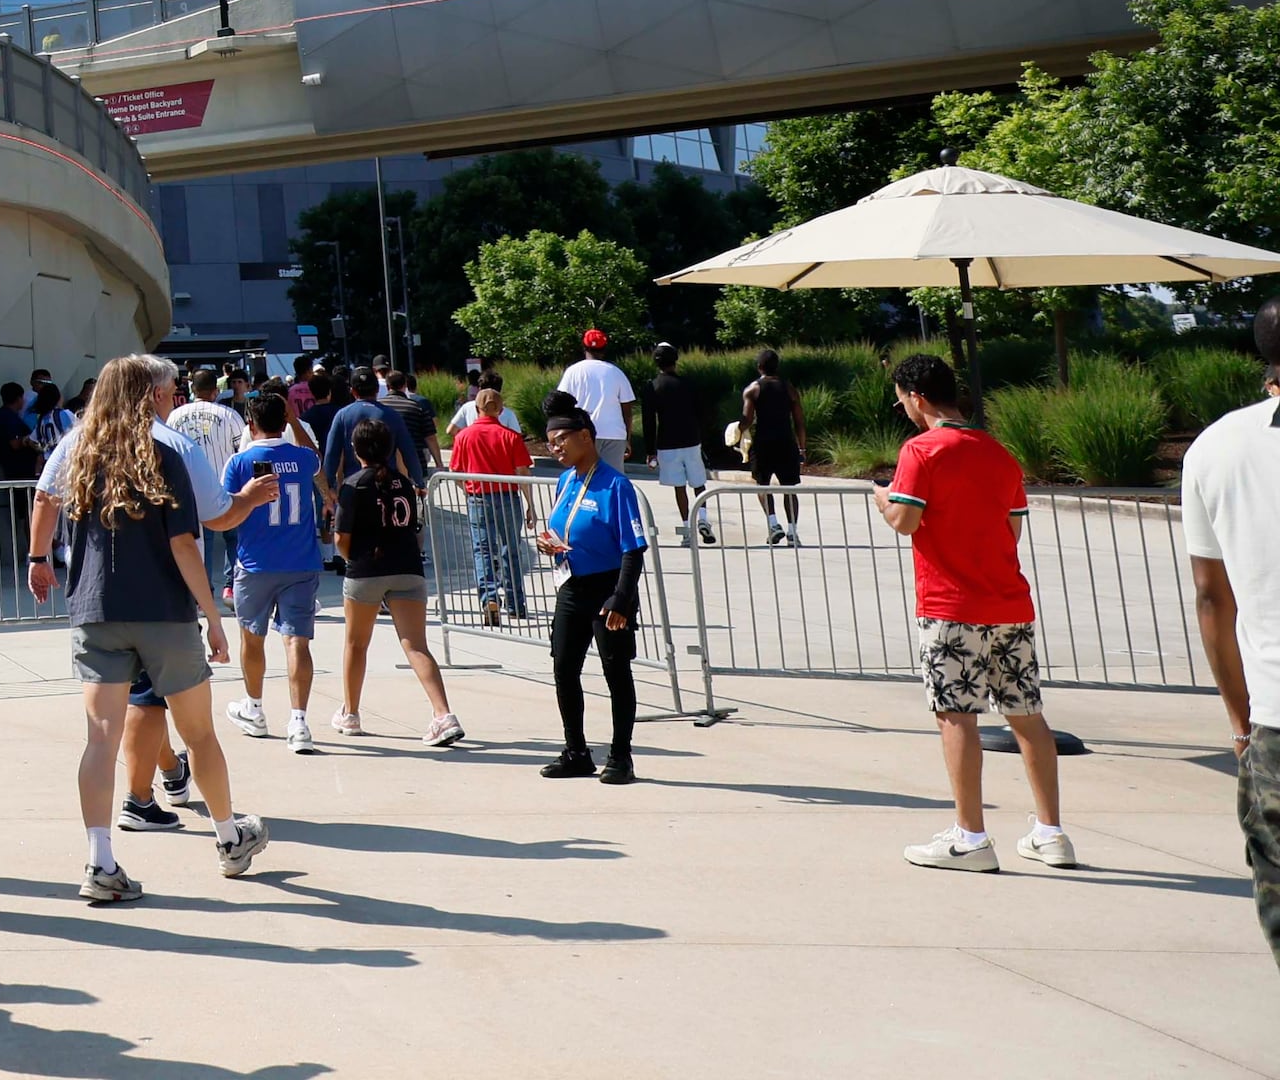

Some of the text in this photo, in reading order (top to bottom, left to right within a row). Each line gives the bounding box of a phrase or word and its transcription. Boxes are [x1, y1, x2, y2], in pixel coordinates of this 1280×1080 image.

[123, 93, 144, 102] Ticket
[145, 90, 165, 99] Office
[108, 98, 182, 114] Home Depot Backyard
[131, 114, 137, 122] &
[138, 112, 155, 121] Suite
[155, 109, 186, 119] Entrance
[272, 461, 299, 474] GICO
[268, 482, 301, 527] 11
[376, 496, 411, 527] 10
